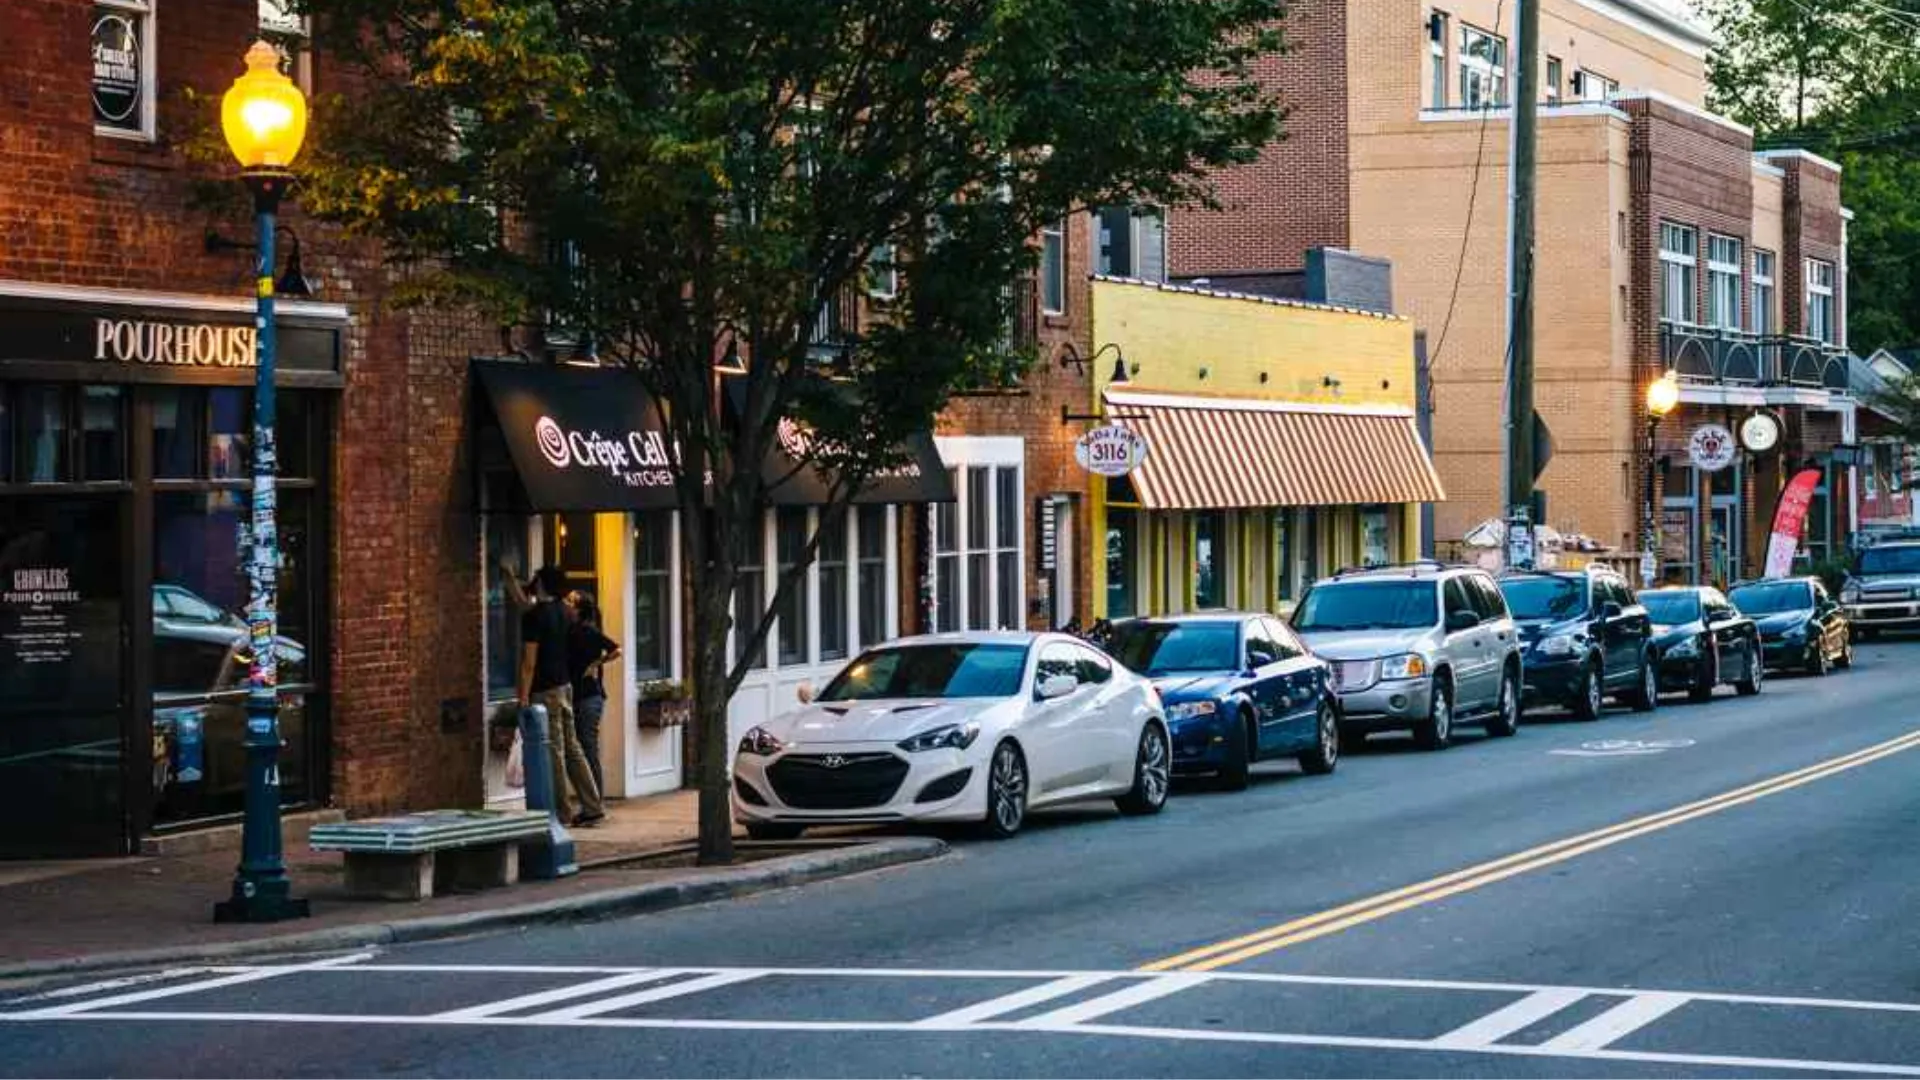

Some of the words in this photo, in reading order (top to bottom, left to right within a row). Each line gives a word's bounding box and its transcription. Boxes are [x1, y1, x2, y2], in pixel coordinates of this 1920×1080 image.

[568, 430, 629, 475] Crêpe
[628, 430, 682, 466] Cell
[1093, 443, 1127, 461] 3116
